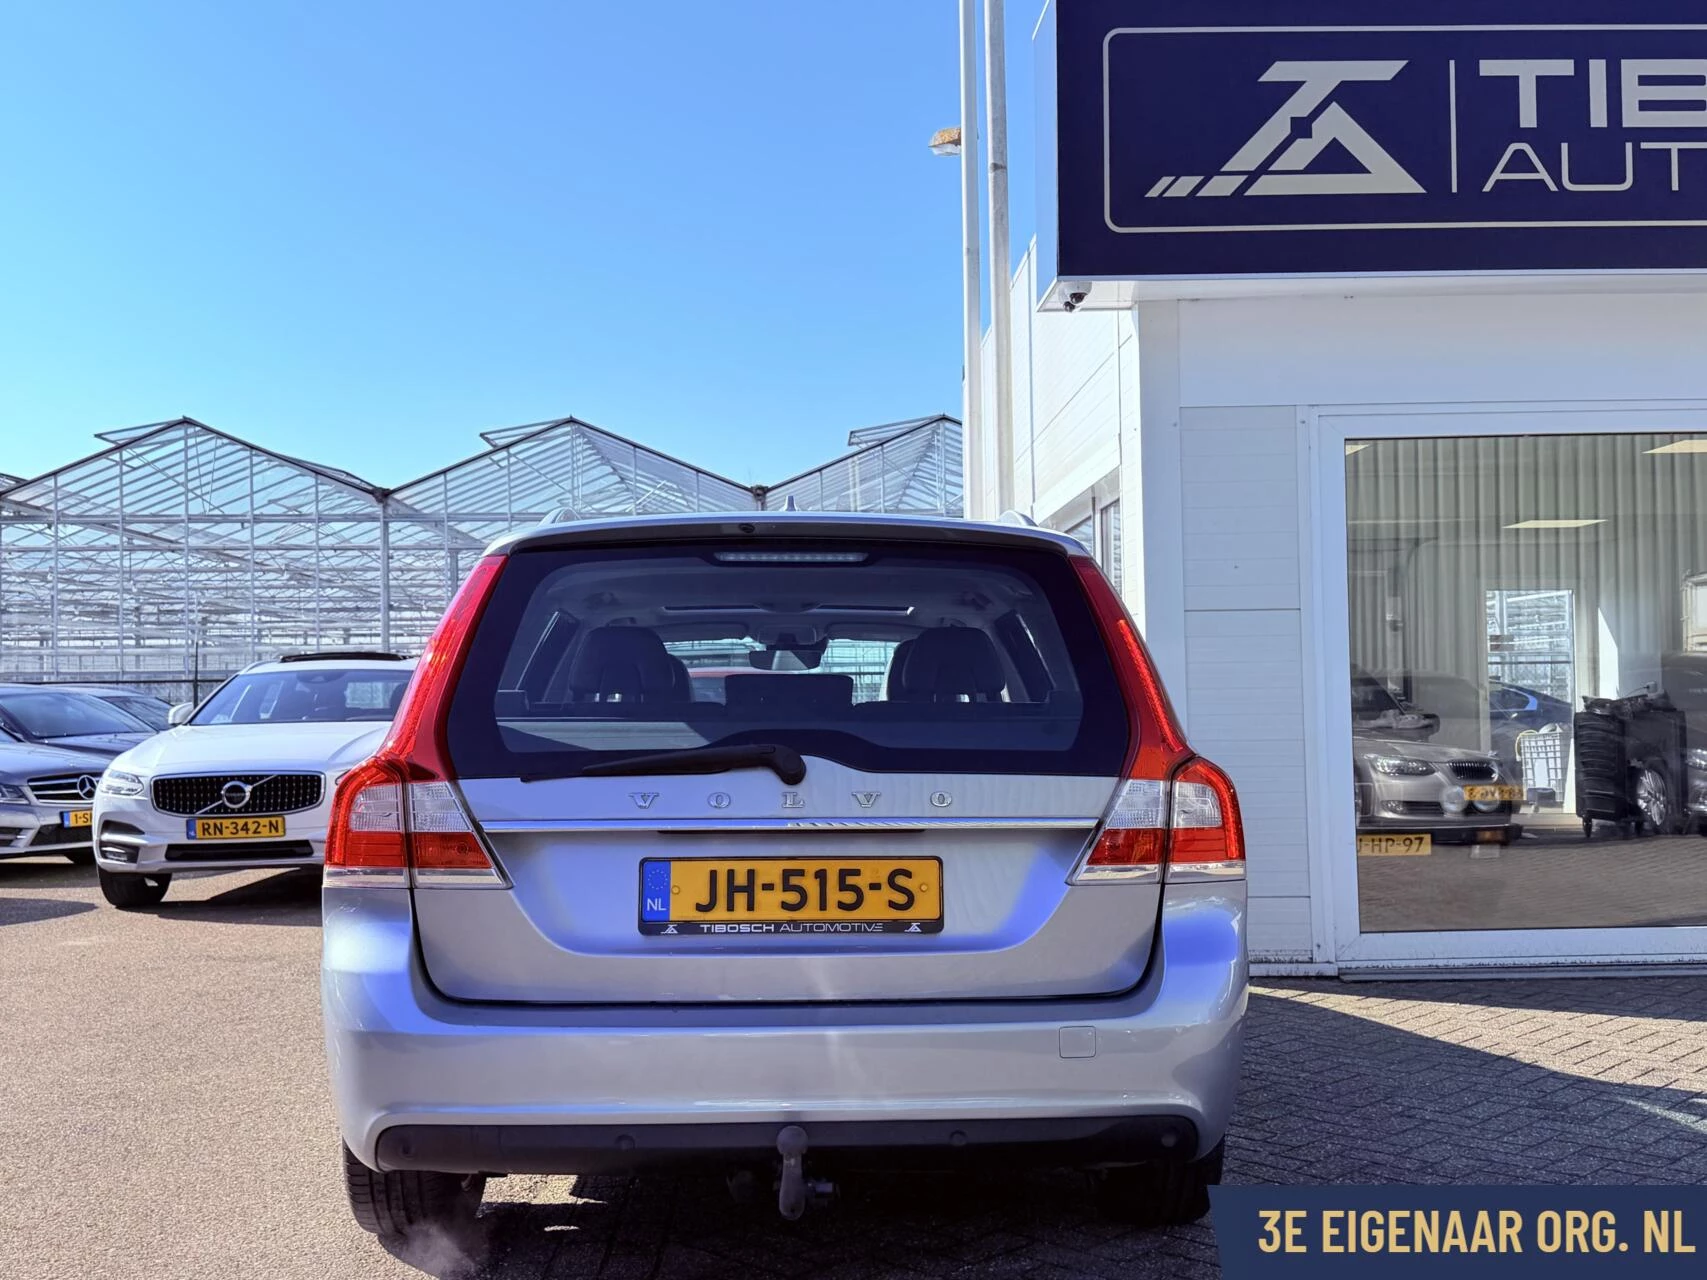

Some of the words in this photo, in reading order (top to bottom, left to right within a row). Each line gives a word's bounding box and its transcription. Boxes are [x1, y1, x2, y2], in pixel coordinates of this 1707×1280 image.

[1479, 58, 1707, 128] TIB
[1482, 141, 1707, 192] AUT
[628, 791, 953, 808] VOLVO
[201, 819, 280, 836] RN-342-N
[695, 868, 915, 913] JH-515-S
[646, 898, 667, 911] NL
[700, 923, 774, 933] TIBOSCH
[779, 922, 883, 932] AUTOMOTIVE
